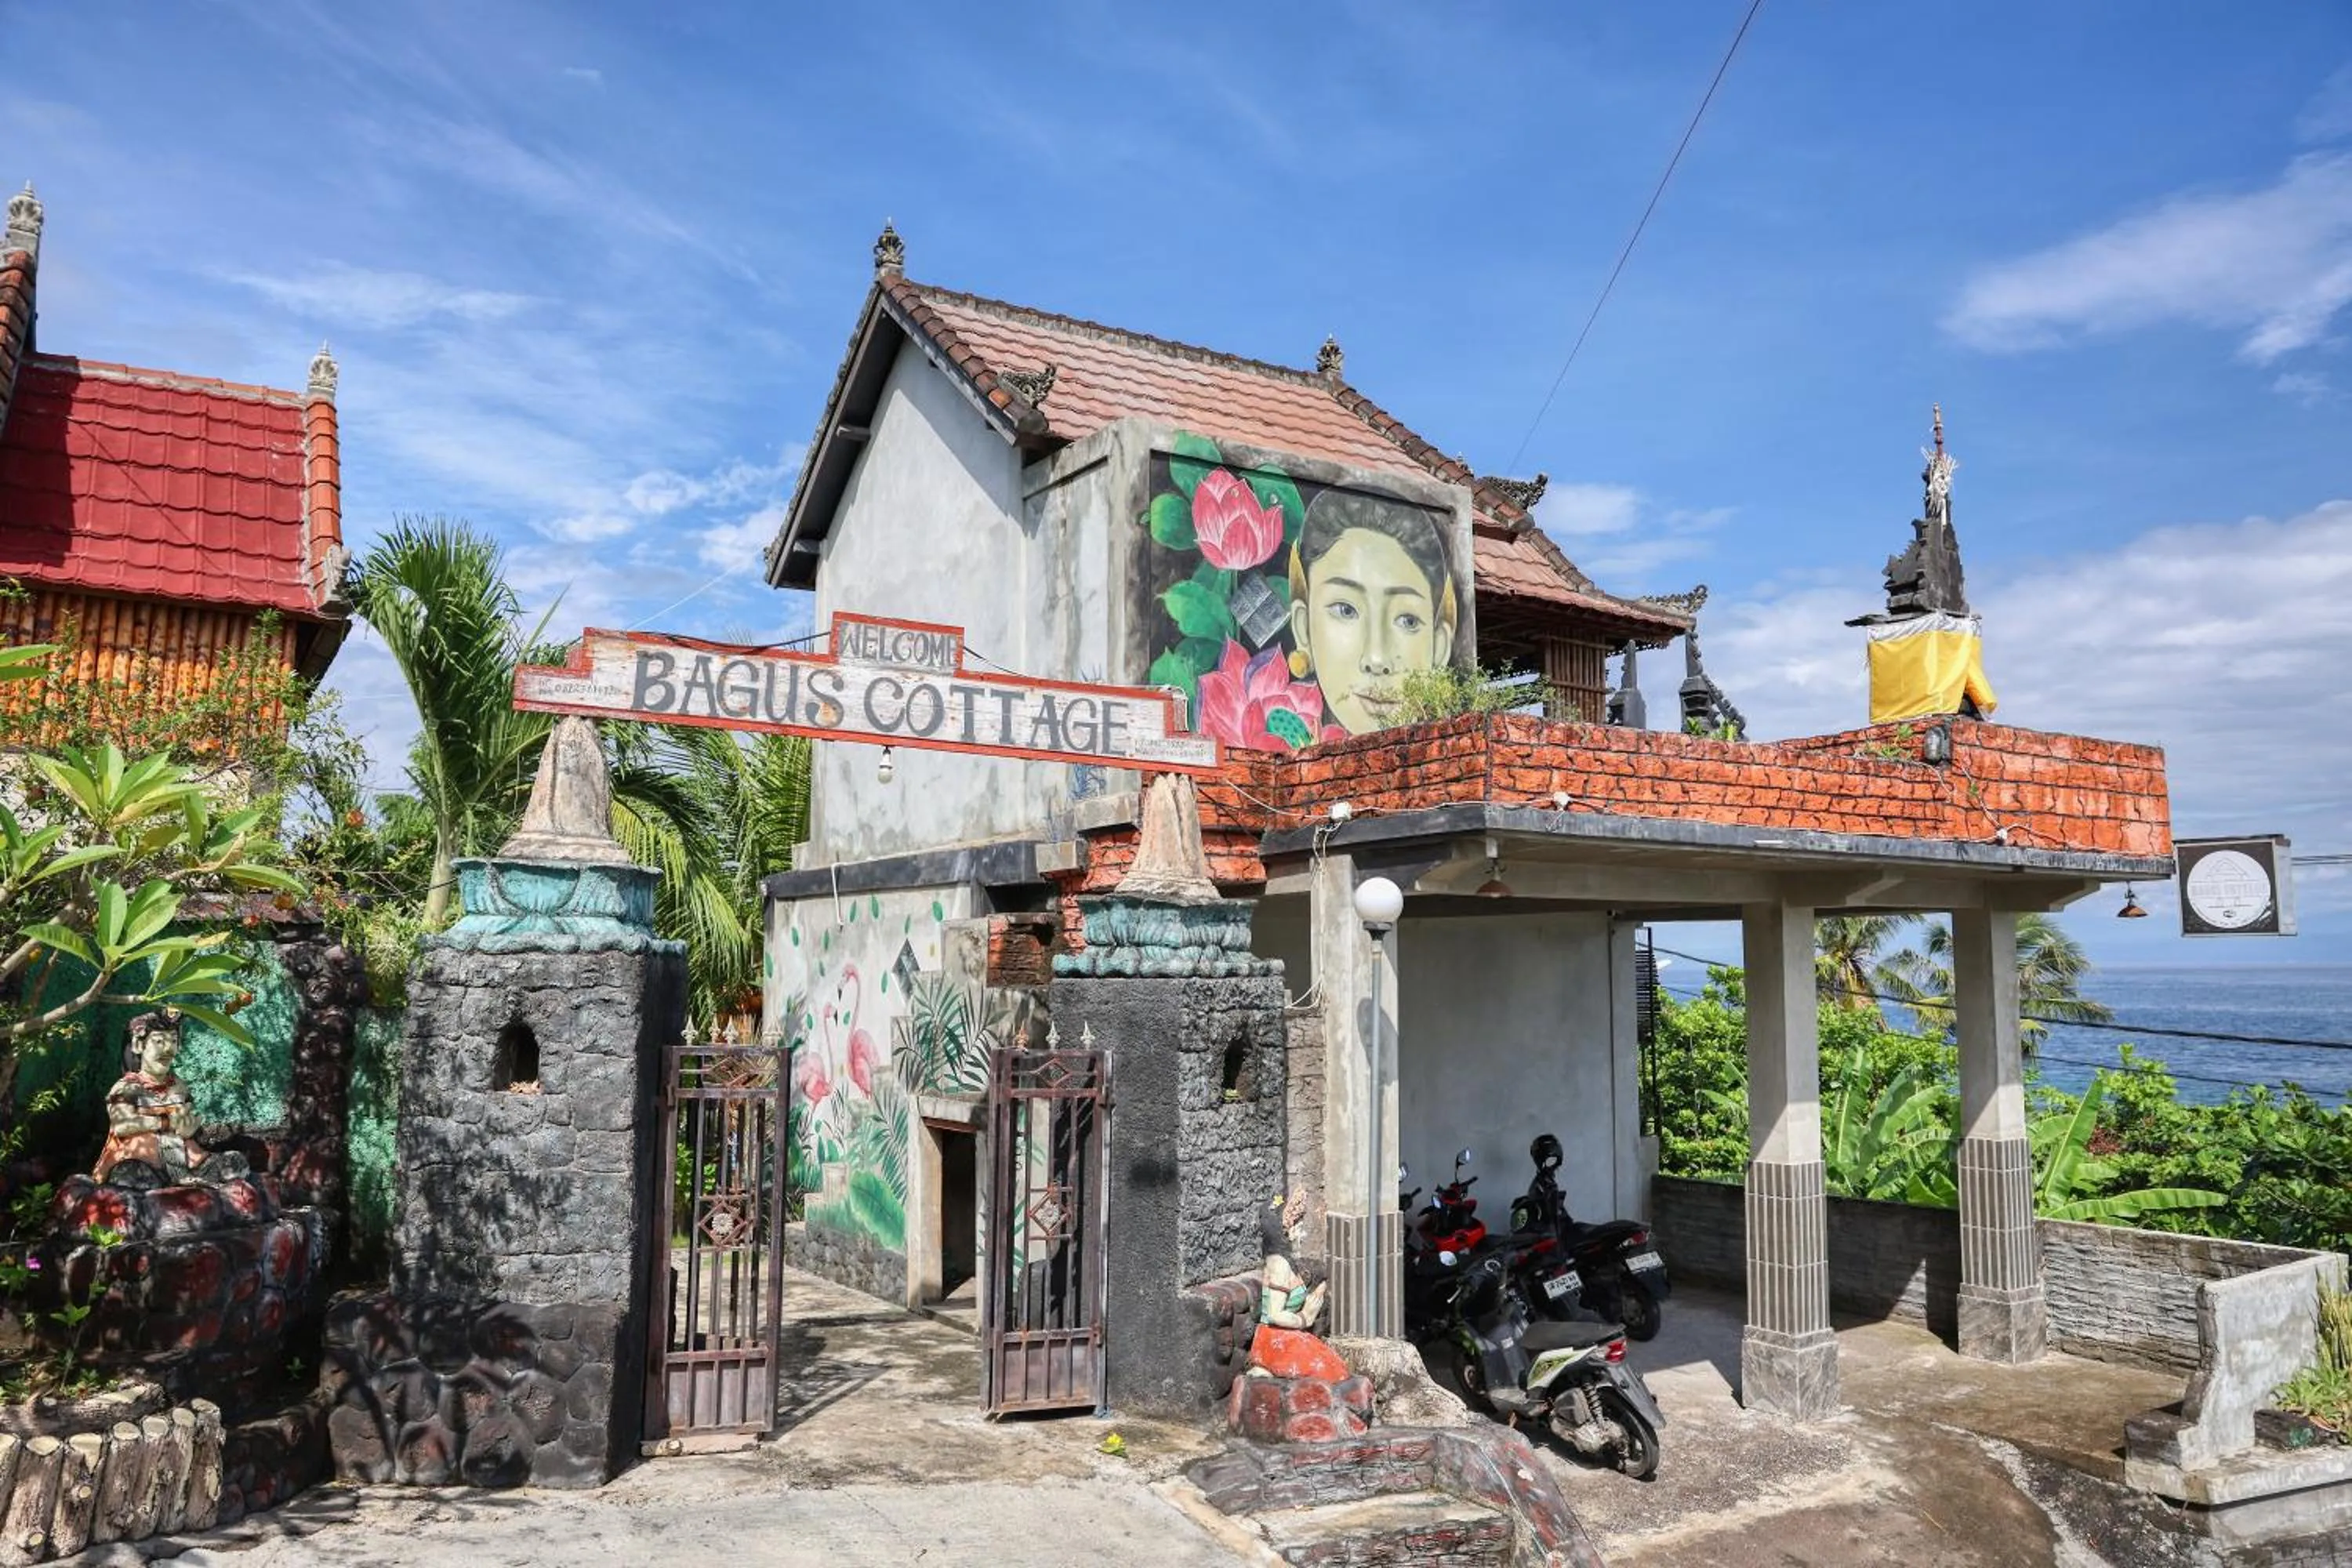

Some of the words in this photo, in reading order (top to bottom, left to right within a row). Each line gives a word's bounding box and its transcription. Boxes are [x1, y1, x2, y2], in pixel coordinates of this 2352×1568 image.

[839, 622, 957, 667] WELCOME
[630, 650, 845, 728] BAGUS
[863, 677, 1129, 756] COTTAGE
